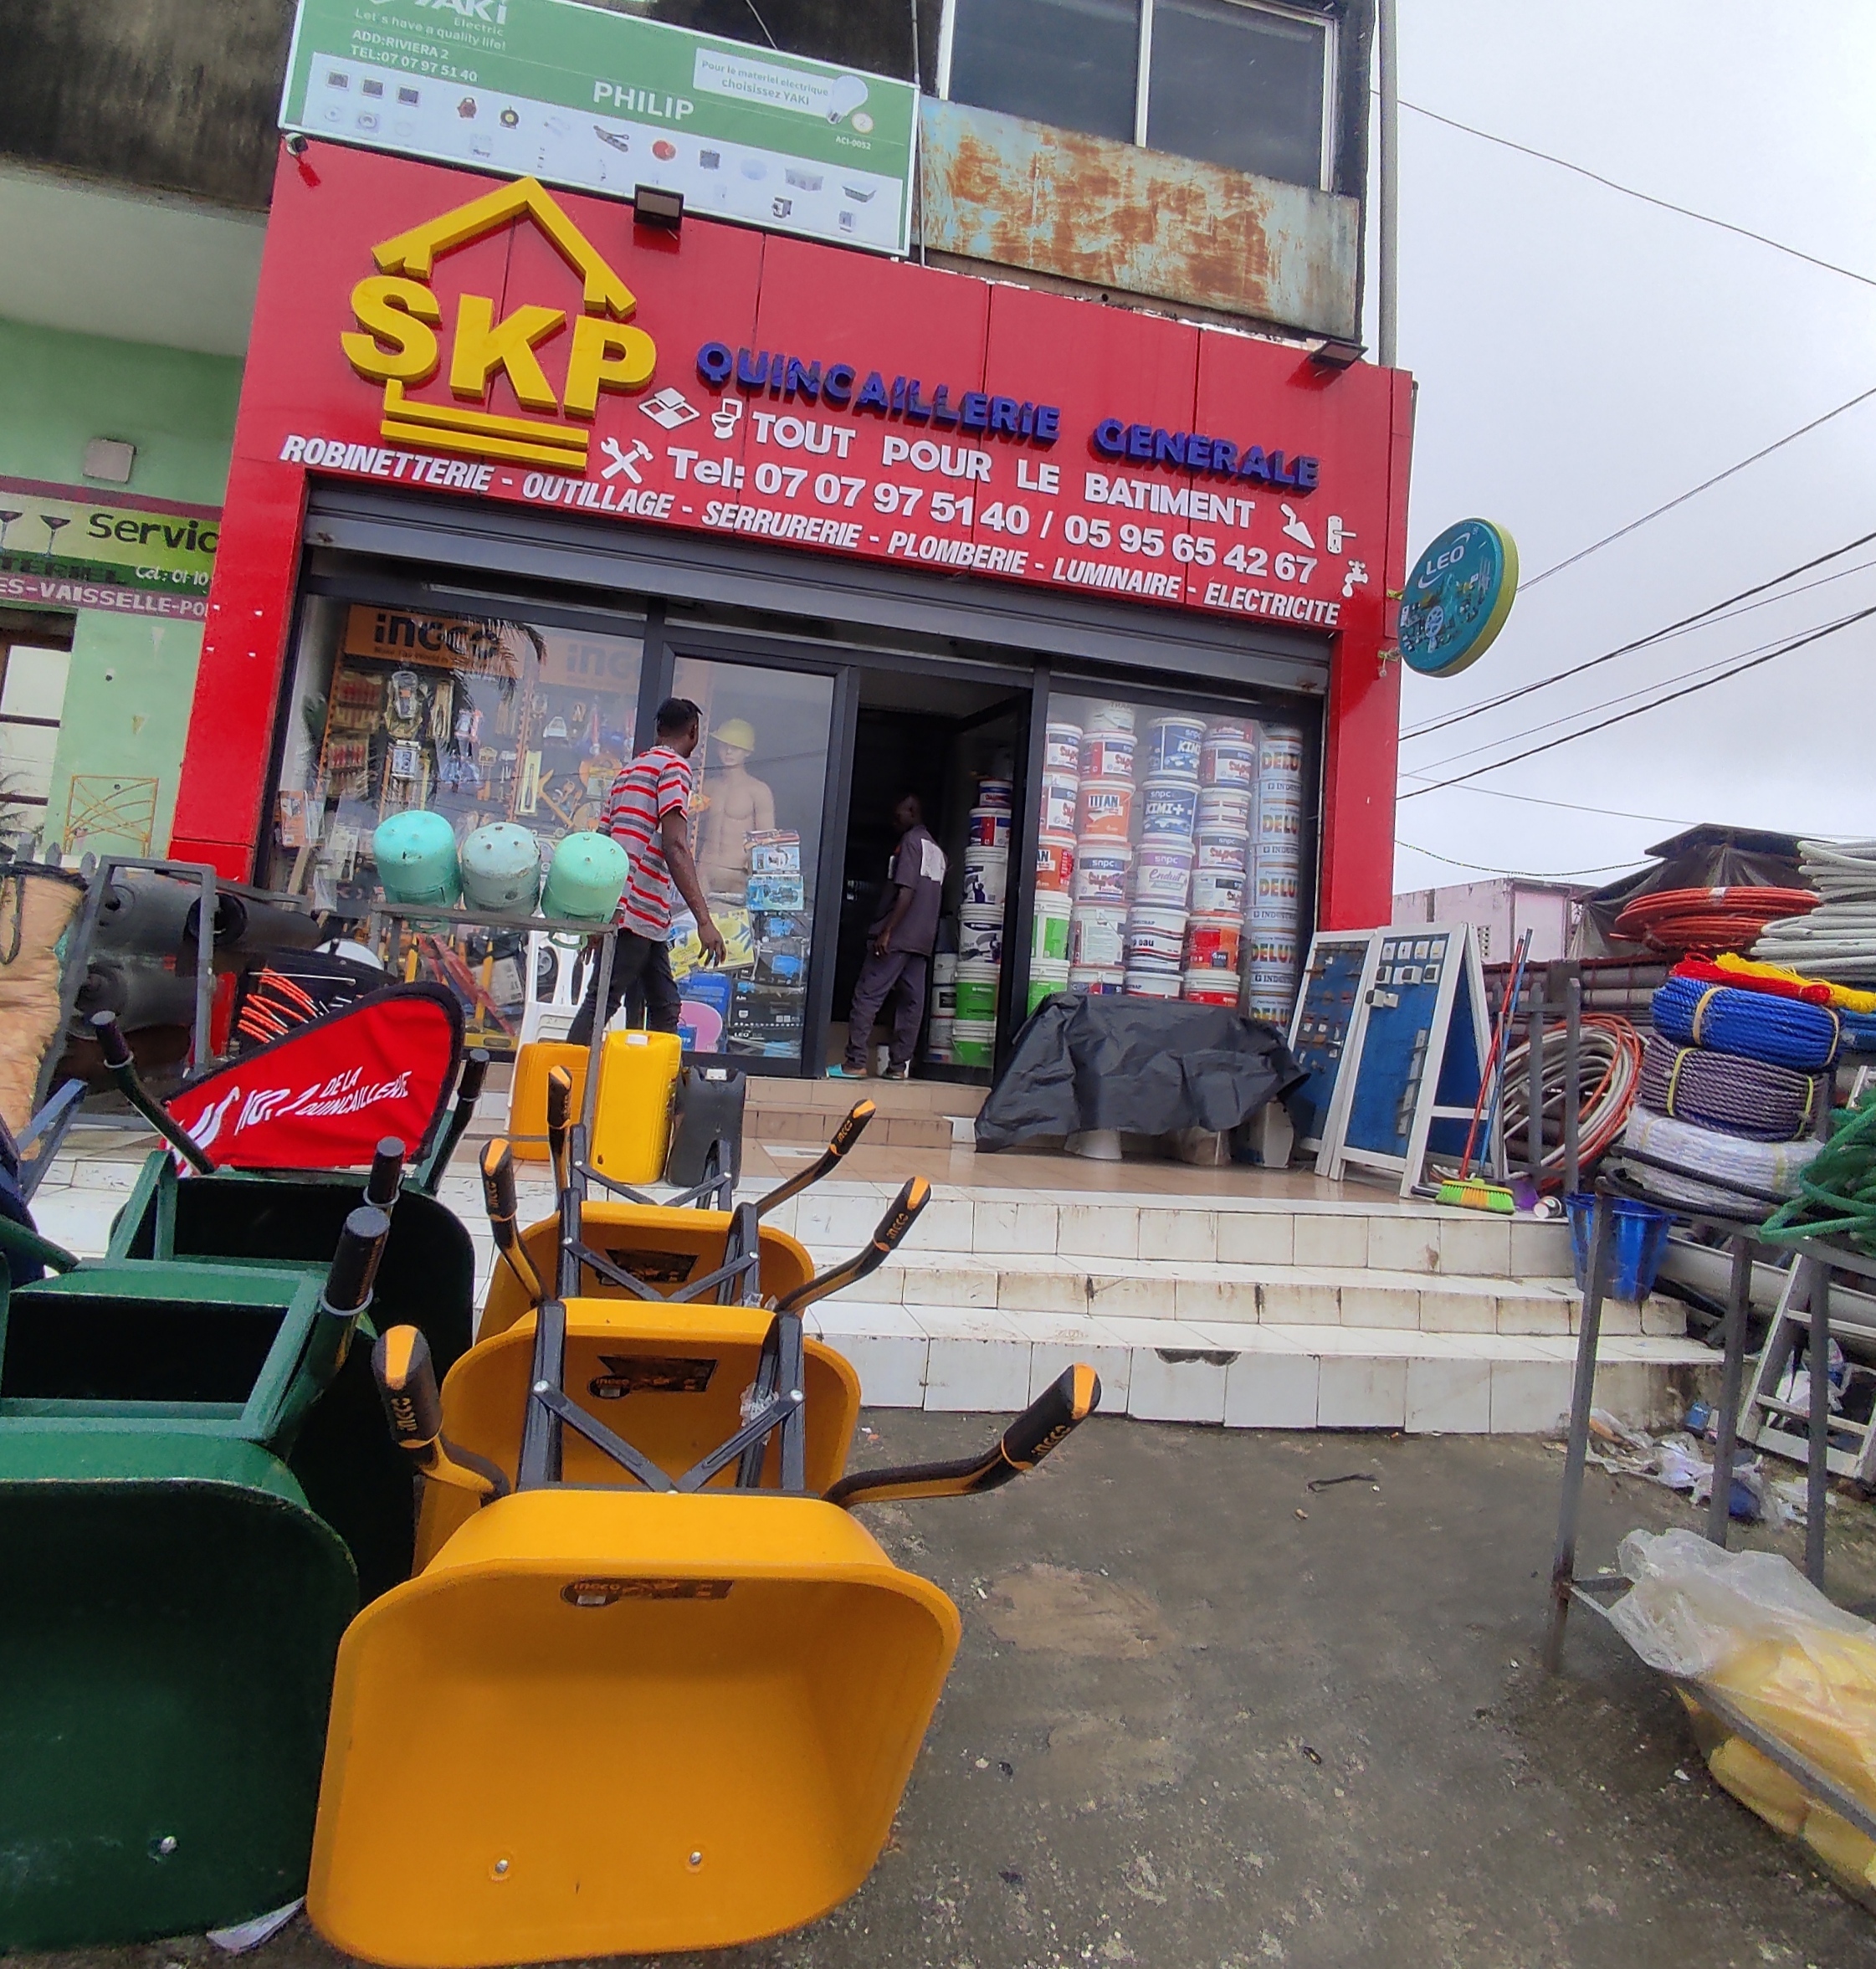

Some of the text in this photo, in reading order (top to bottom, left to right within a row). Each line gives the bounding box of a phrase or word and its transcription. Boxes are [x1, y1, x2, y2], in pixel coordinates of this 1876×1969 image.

[392, 16, 423, 33] have
[426, 25, 434, 35] a
[437, 27, 479, 46] quality
[482, 36, 506, 51] life!
[454, 17, 504, 37] Electric
[352, 29, 449, 60] ADD:RIVIERA 2
[401, 55, 419, 69] 07
[421, 60, 439, 74] 97
[440, 64, 457, 79] 51
[460, 69, 478, 83] 40
[701, 59, 725, 74] Pour
[727, 64, 736, 75] le
[738, 68, 779, 85] materiel
[592, 80, 695, 121] PHILIP
[721, 78, 810, 106] choisissez YAKI
[835, 135, 872, 151] ACI-0052
[340, 275, 658, 418] SKP
[752, 411, 1256, 529] TOUT POUR LE BATIMENT
[1091, 418, 1320, 493] GENERALE
[279, 434, 496, 491] ROBINETTERIE
[521, 472, 675, 520] OUTILLAGE
[701, 500, 864, 549] SERRURERIE
[886, 531, 1030, 576] PLOMBERIE
[1052, 556, 1181, 599] LUMINAIRE
[1202, 582, 1342, 627] ELECTRICITE
[668, 446, 1319, 584] Tel: 07 07 97 51 40 / 05 95 65 42 67
[86, 512, 219, 554] Servic
[1426, 545, 1465, 576] LEO
[0, 577, 208, 618] ES-VAISSELLE-PO
[1089, 795, 1120, 808] TITAN
[1092, 859, 1115, 869] snpc
[1155, 855, 1179, 864] snpc
[319, 1066, 363, 1099] DE LA
